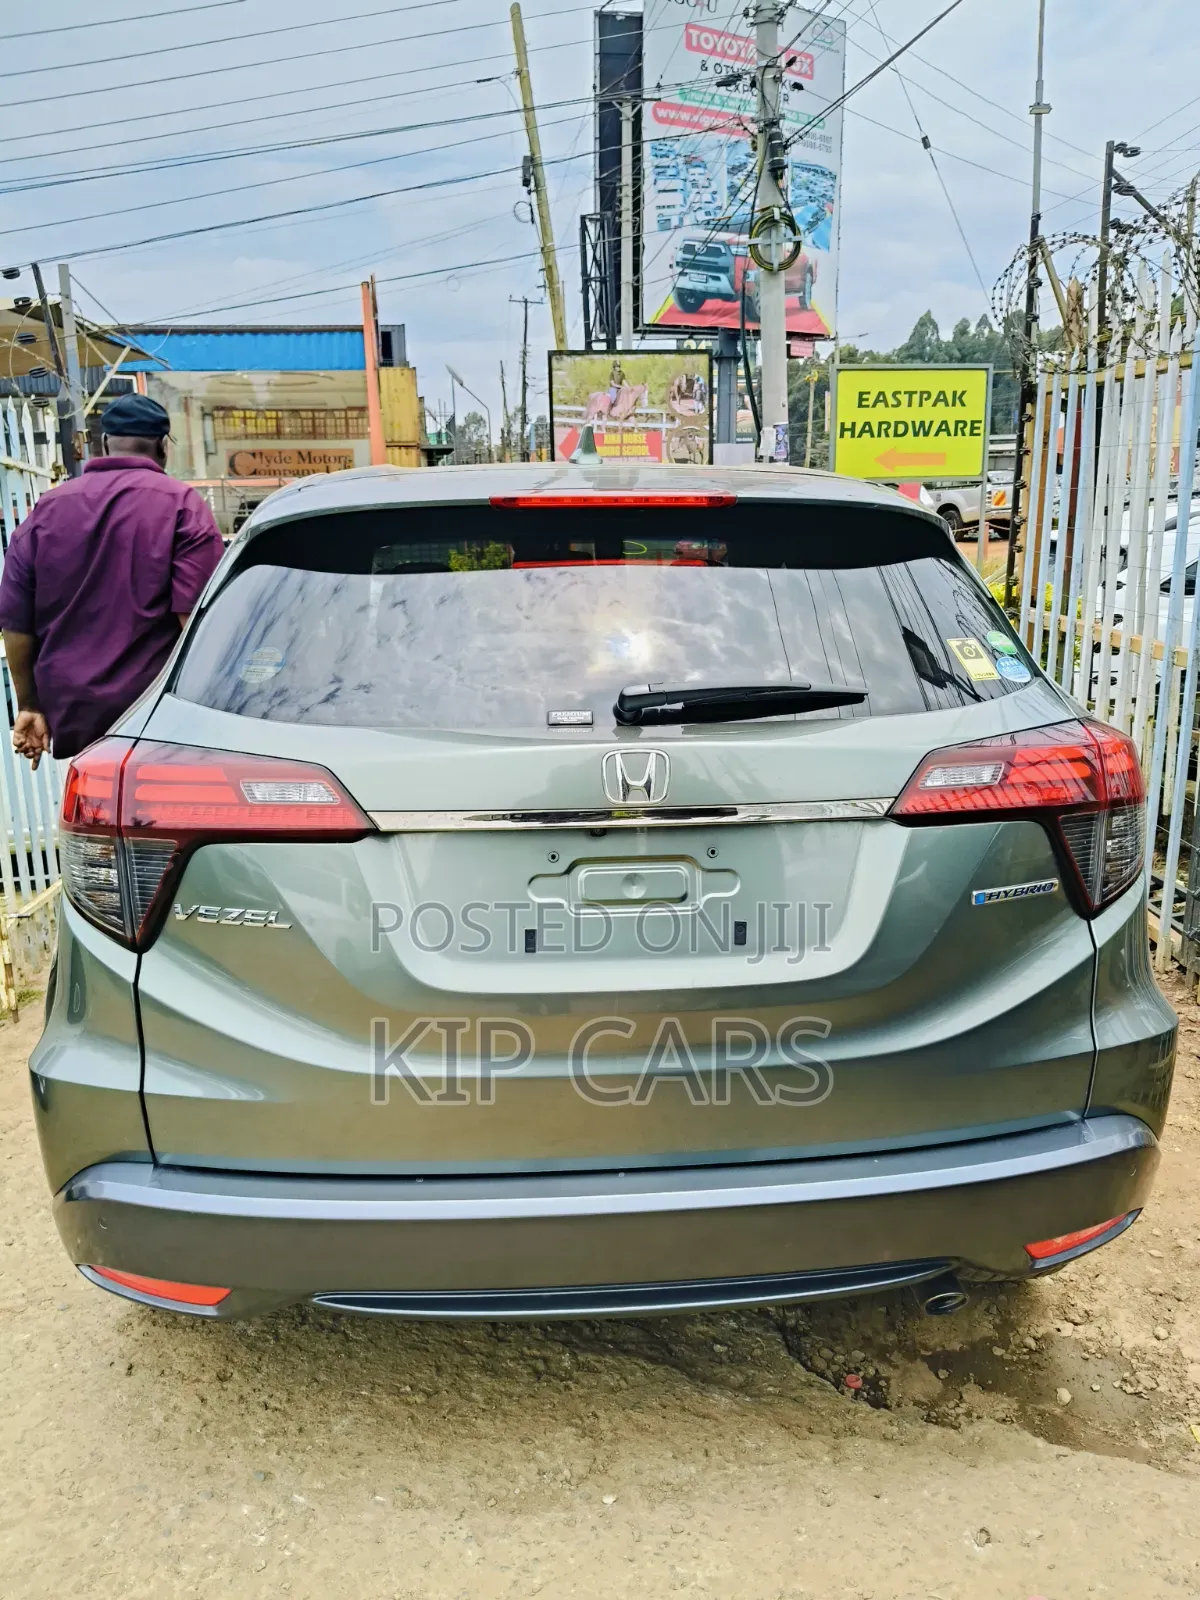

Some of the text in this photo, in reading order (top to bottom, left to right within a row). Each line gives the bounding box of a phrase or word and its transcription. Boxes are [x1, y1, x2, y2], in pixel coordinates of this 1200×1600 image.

[857, 390, 968, 409] EASTPAK
[839, 420, 983, 439] HARDWARE
[297, 450, 352, 465] Motors
[986, 881, 1055, 901] HYBRID
[174, 903, 292, 929] VEZEL
